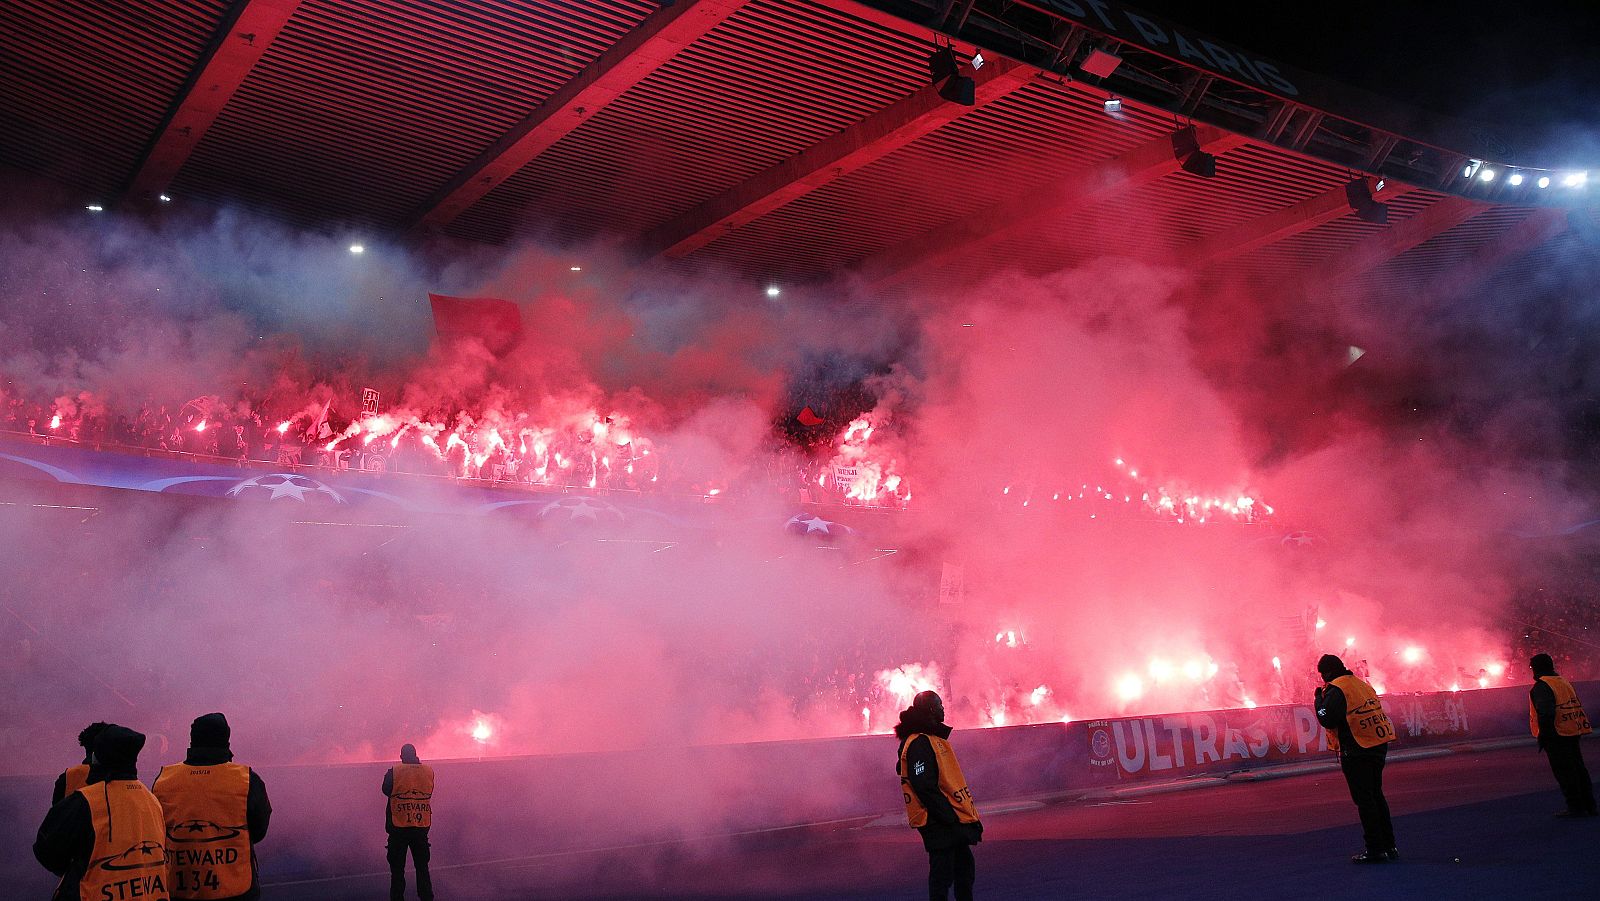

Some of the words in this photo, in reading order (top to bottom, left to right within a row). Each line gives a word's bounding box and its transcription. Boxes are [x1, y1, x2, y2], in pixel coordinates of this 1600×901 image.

[1124, 10, 1298, 95] PARIS
[1112, 714, 1269, 773] ULTRAS
[175, 869, 220, 891] 134
